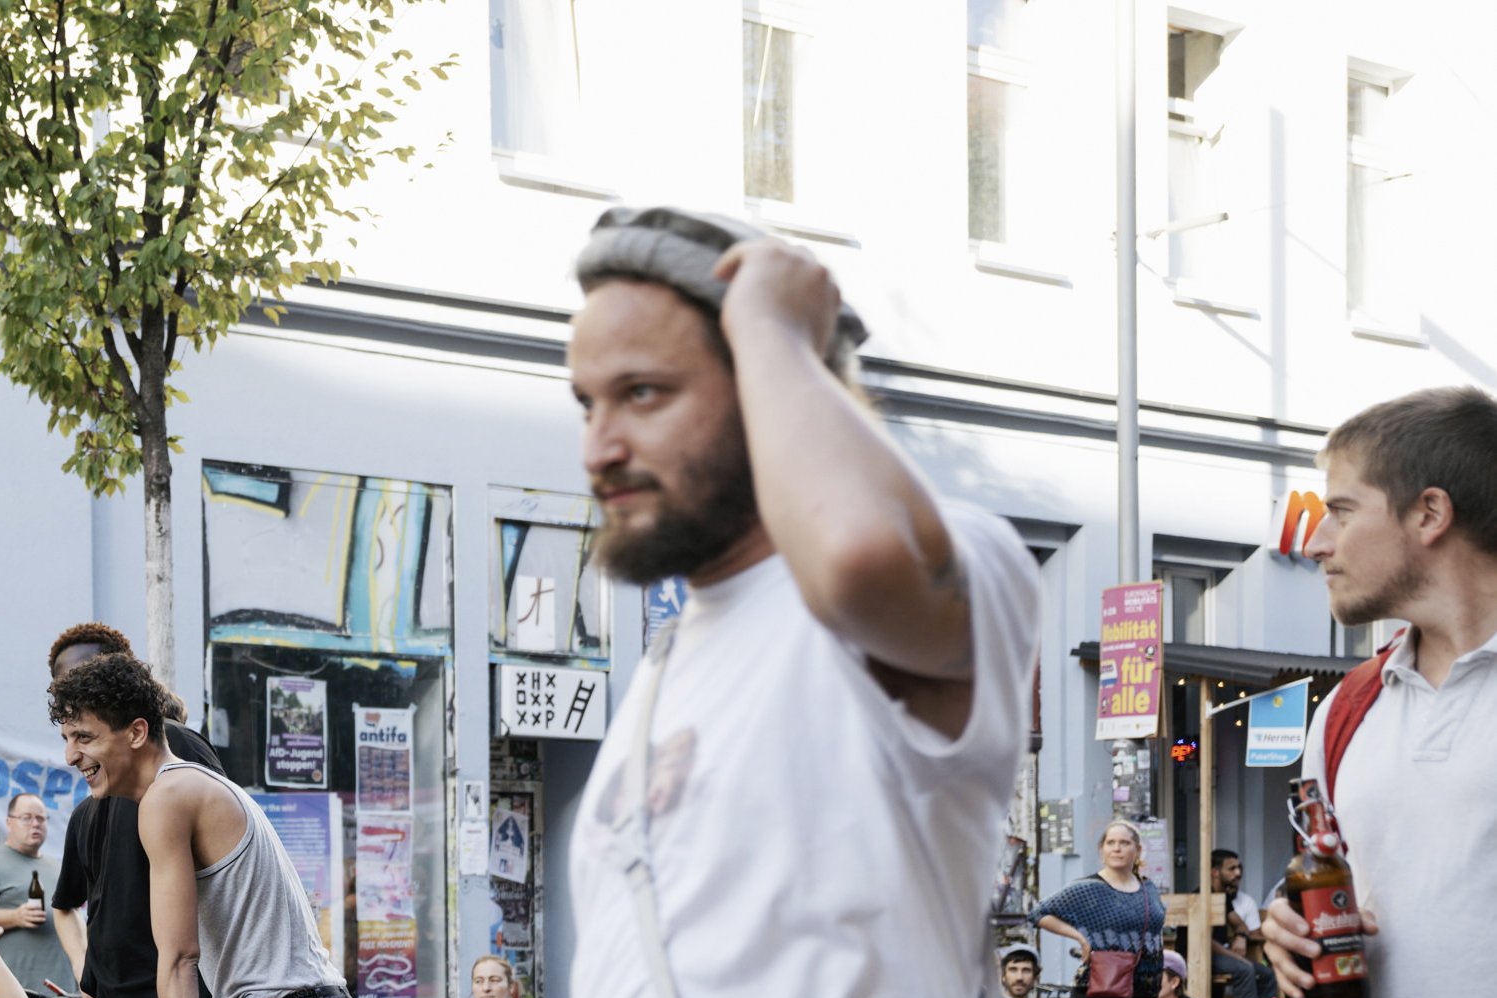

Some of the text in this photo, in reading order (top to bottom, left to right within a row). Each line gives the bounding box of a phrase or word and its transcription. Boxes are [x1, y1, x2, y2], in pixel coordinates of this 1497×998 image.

[1102, 619, 1157, 642] Mobilität
[1121, 656, 1157, 685] für
[1111, 686, 1150, 715] alle
[359, 726, 407, 743] antifa
[269, 748, 323, 761] AfD-Jugend
[276, 760, 316, 772] stoppen!
